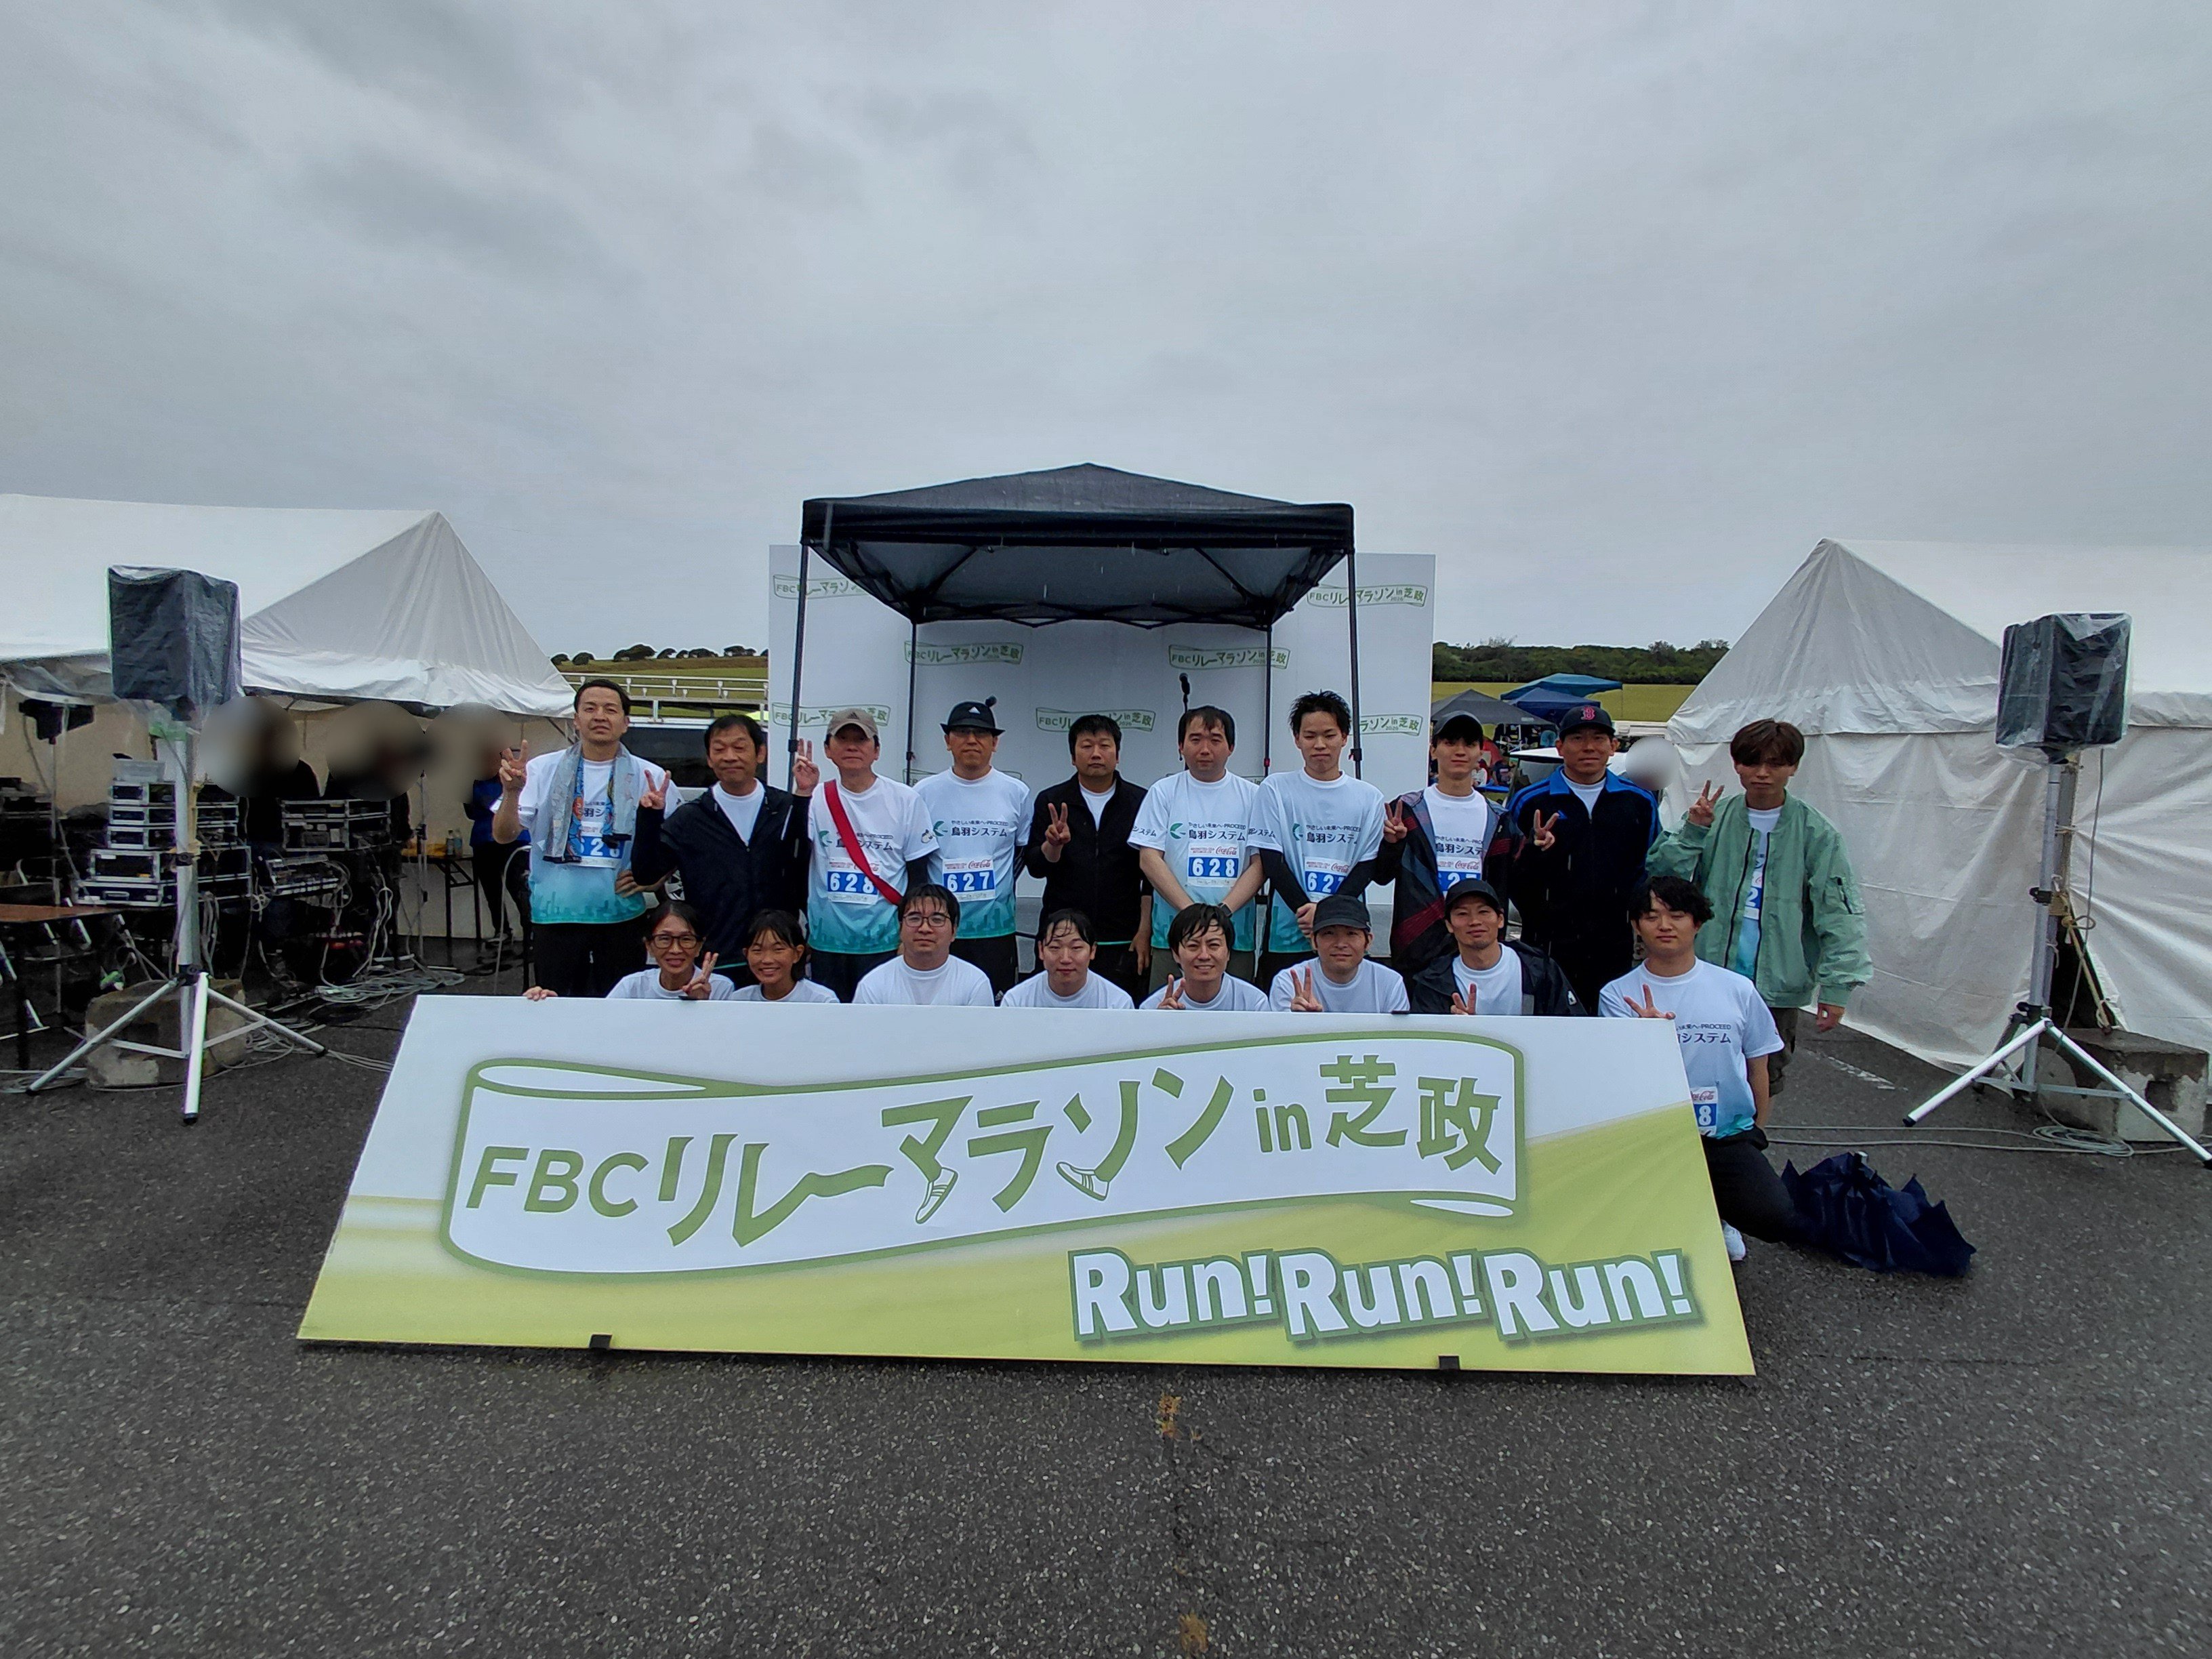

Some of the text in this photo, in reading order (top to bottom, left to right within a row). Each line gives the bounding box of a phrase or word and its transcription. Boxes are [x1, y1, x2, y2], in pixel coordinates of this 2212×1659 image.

[951, 826, 1008, 837] 鳥羽システム
[1188, 830, 1246, 842] 鳥羽システム
[1306, 832, 1358, 844] 鳥羽システ
[1192, 858, 1235, 877] 628
[830, 872, 874, 894] 628
[947, 872, 990, 893] 627
[466, 1054, 1502, 1247] FBCリレーマラソンin芝政
